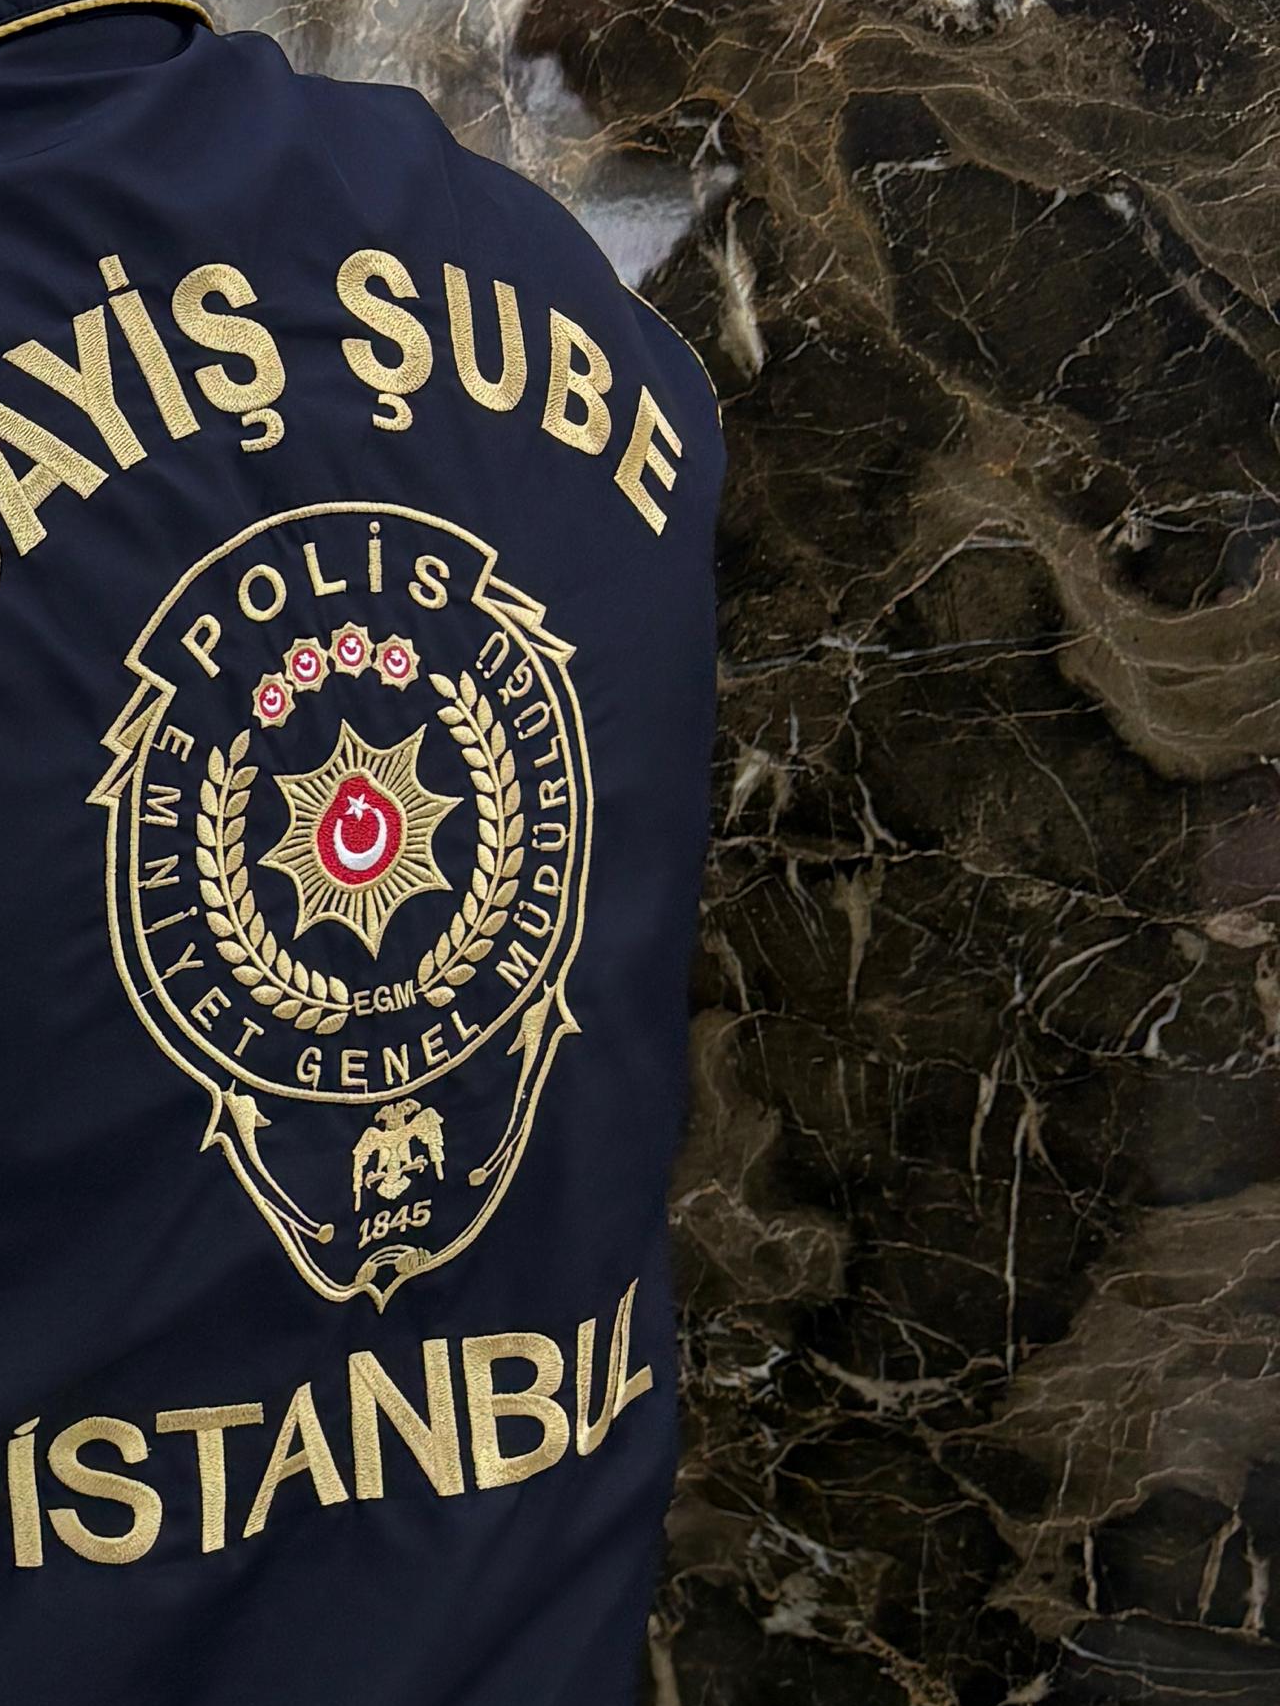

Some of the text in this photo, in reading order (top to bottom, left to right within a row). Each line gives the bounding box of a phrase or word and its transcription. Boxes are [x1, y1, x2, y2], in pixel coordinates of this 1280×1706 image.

[336, 248, 683, 535] ŞUBE
[181, 520, 449, 679] POLİS
[139, 723, 264, 1057] EMNİYET
[297, 1016, 483, 1091] GENEL
[354, 978, 417, 1019] EGM
[357, 1202, 432, 1250] 1845
[7, 1278, 653, 1568] İSTANBUL
